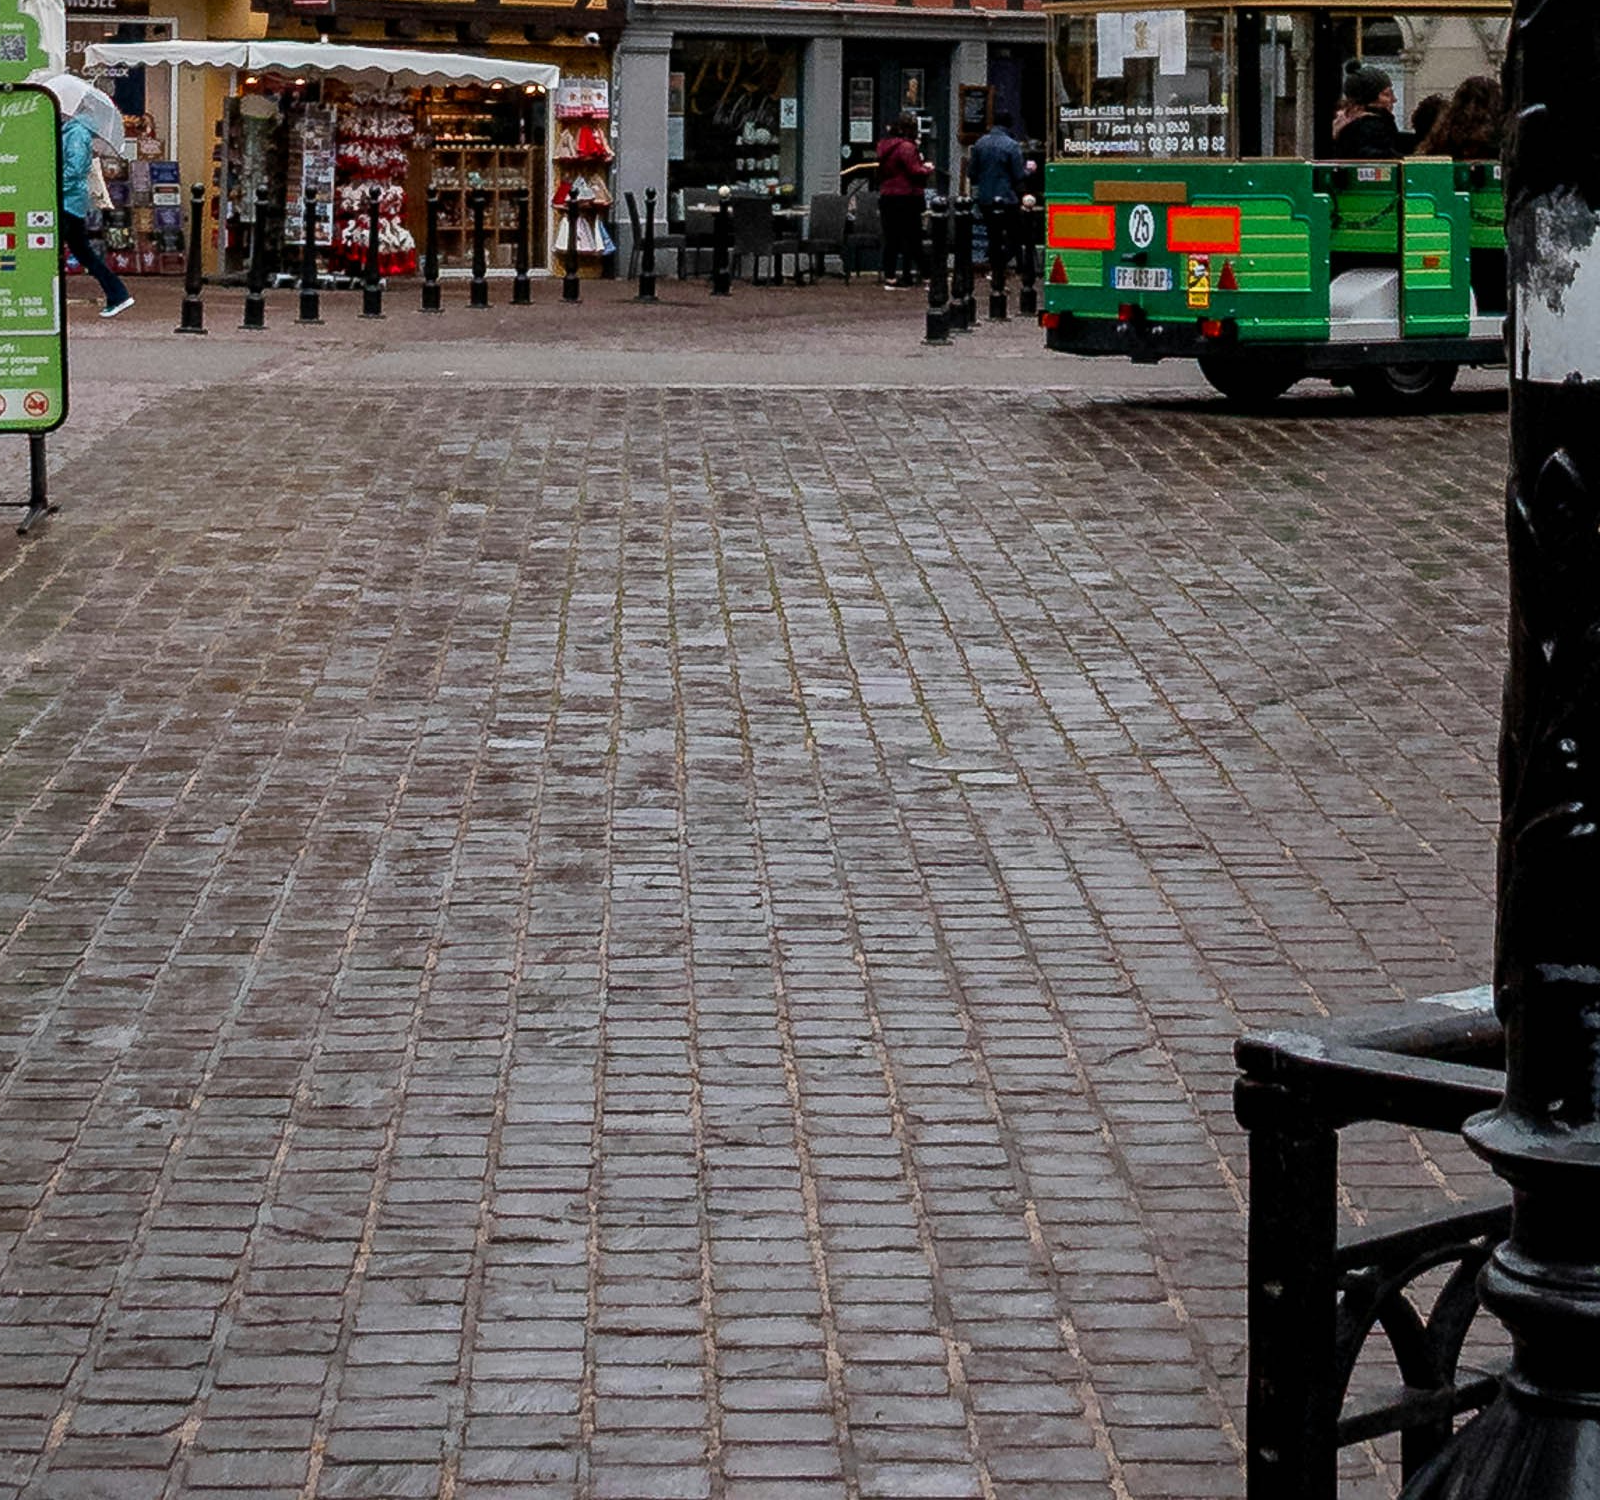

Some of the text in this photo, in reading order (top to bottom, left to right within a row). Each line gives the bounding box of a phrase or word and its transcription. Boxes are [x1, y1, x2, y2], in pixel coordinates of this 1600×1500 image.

[1060, 106, 1083, 118] Départ
[1084, 106, 1097, 117] Rue
[1126, 107, 1136, 116] en
[1137, 104, 1152, 116] face
[1112, 121, 1131, 136] jours
[1133, 121, 1144, 134] de
[1064, 138, 1140, 155] Renseignements
[1149, 137, 1163, 151] 03
[1165, 137, 1179, 151] 89
[1181, 136, 1195, 151] 24
[1197, 136, 1209, 151] 19
[1133, 209, 1151, 243] 25
